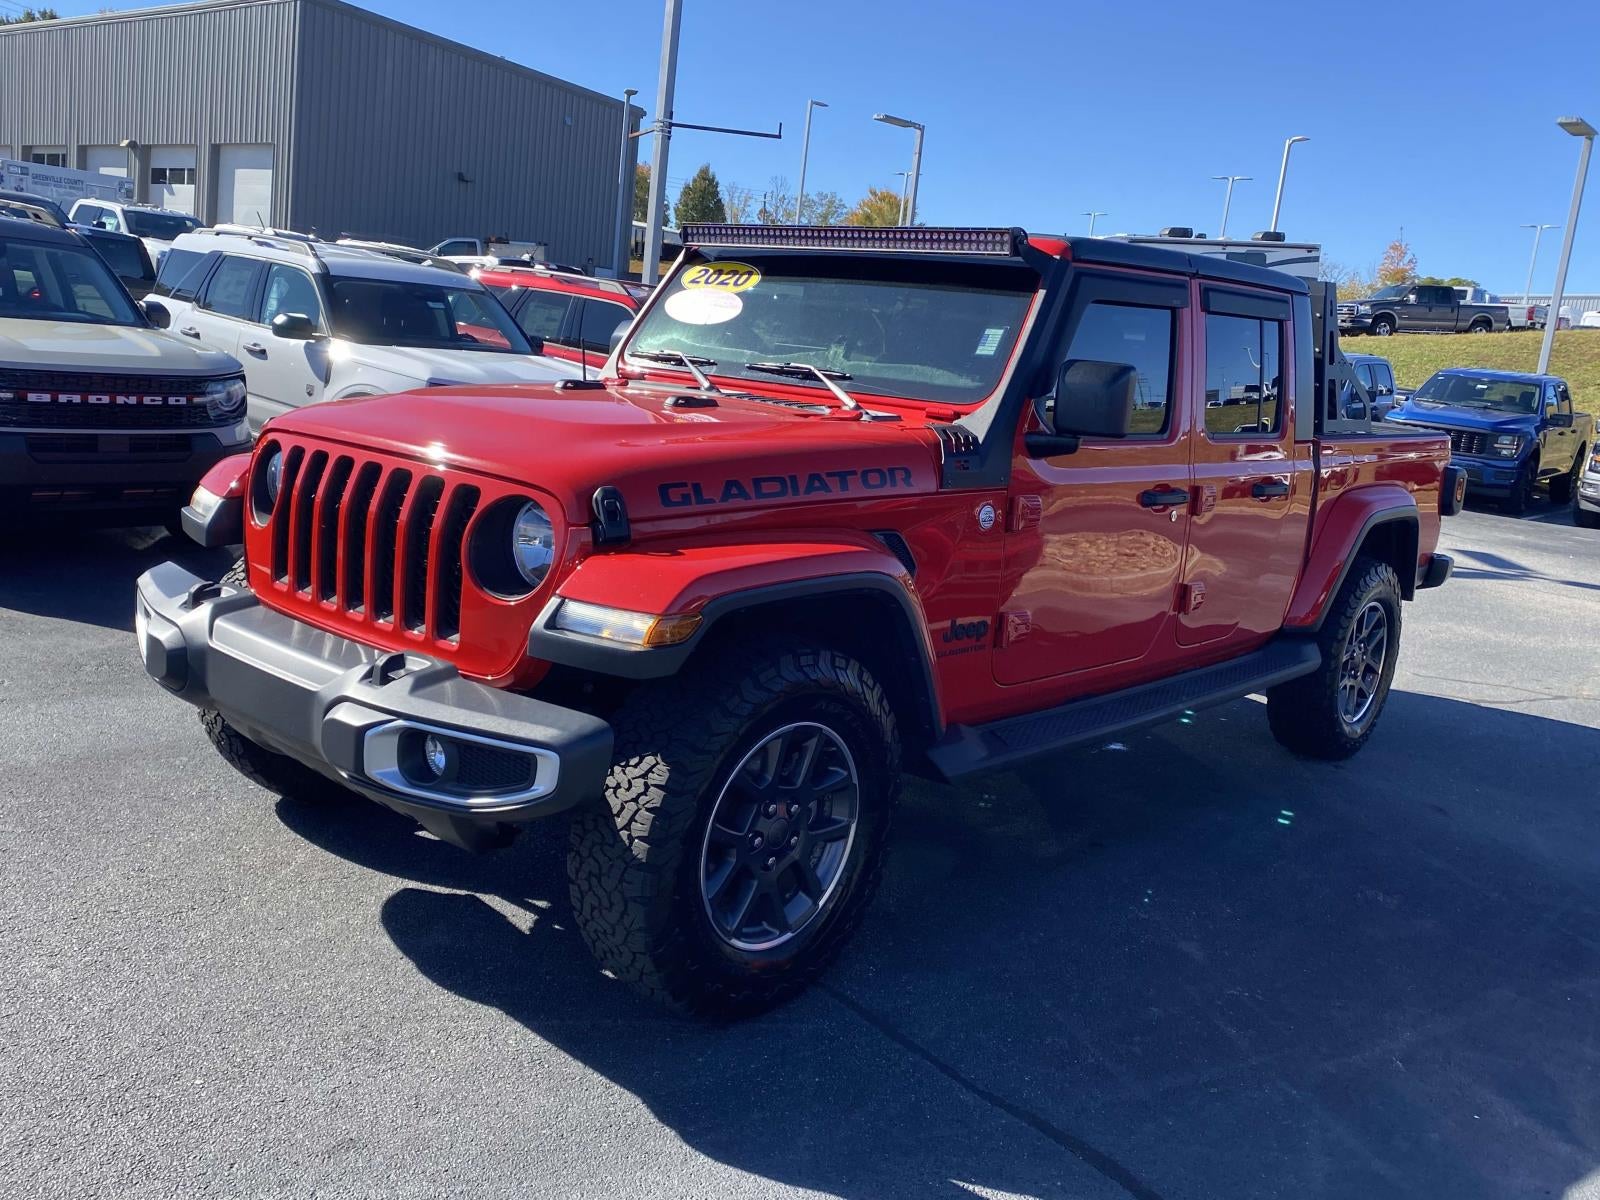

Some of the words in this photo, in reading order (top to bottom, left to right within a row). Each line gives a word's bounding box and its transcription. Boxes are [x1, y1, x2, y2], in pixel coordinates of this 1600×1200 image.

[31, 173, 63, 184] GREENVILLE
[63, 177, 84, 186] COUNTY
[688, 268, 754, 287] 2020
[27, 393, 187, 405] BRONCO
[657, 466, 915, 508] GLADIATOR
[943, 618, 989, 643] Jeep
